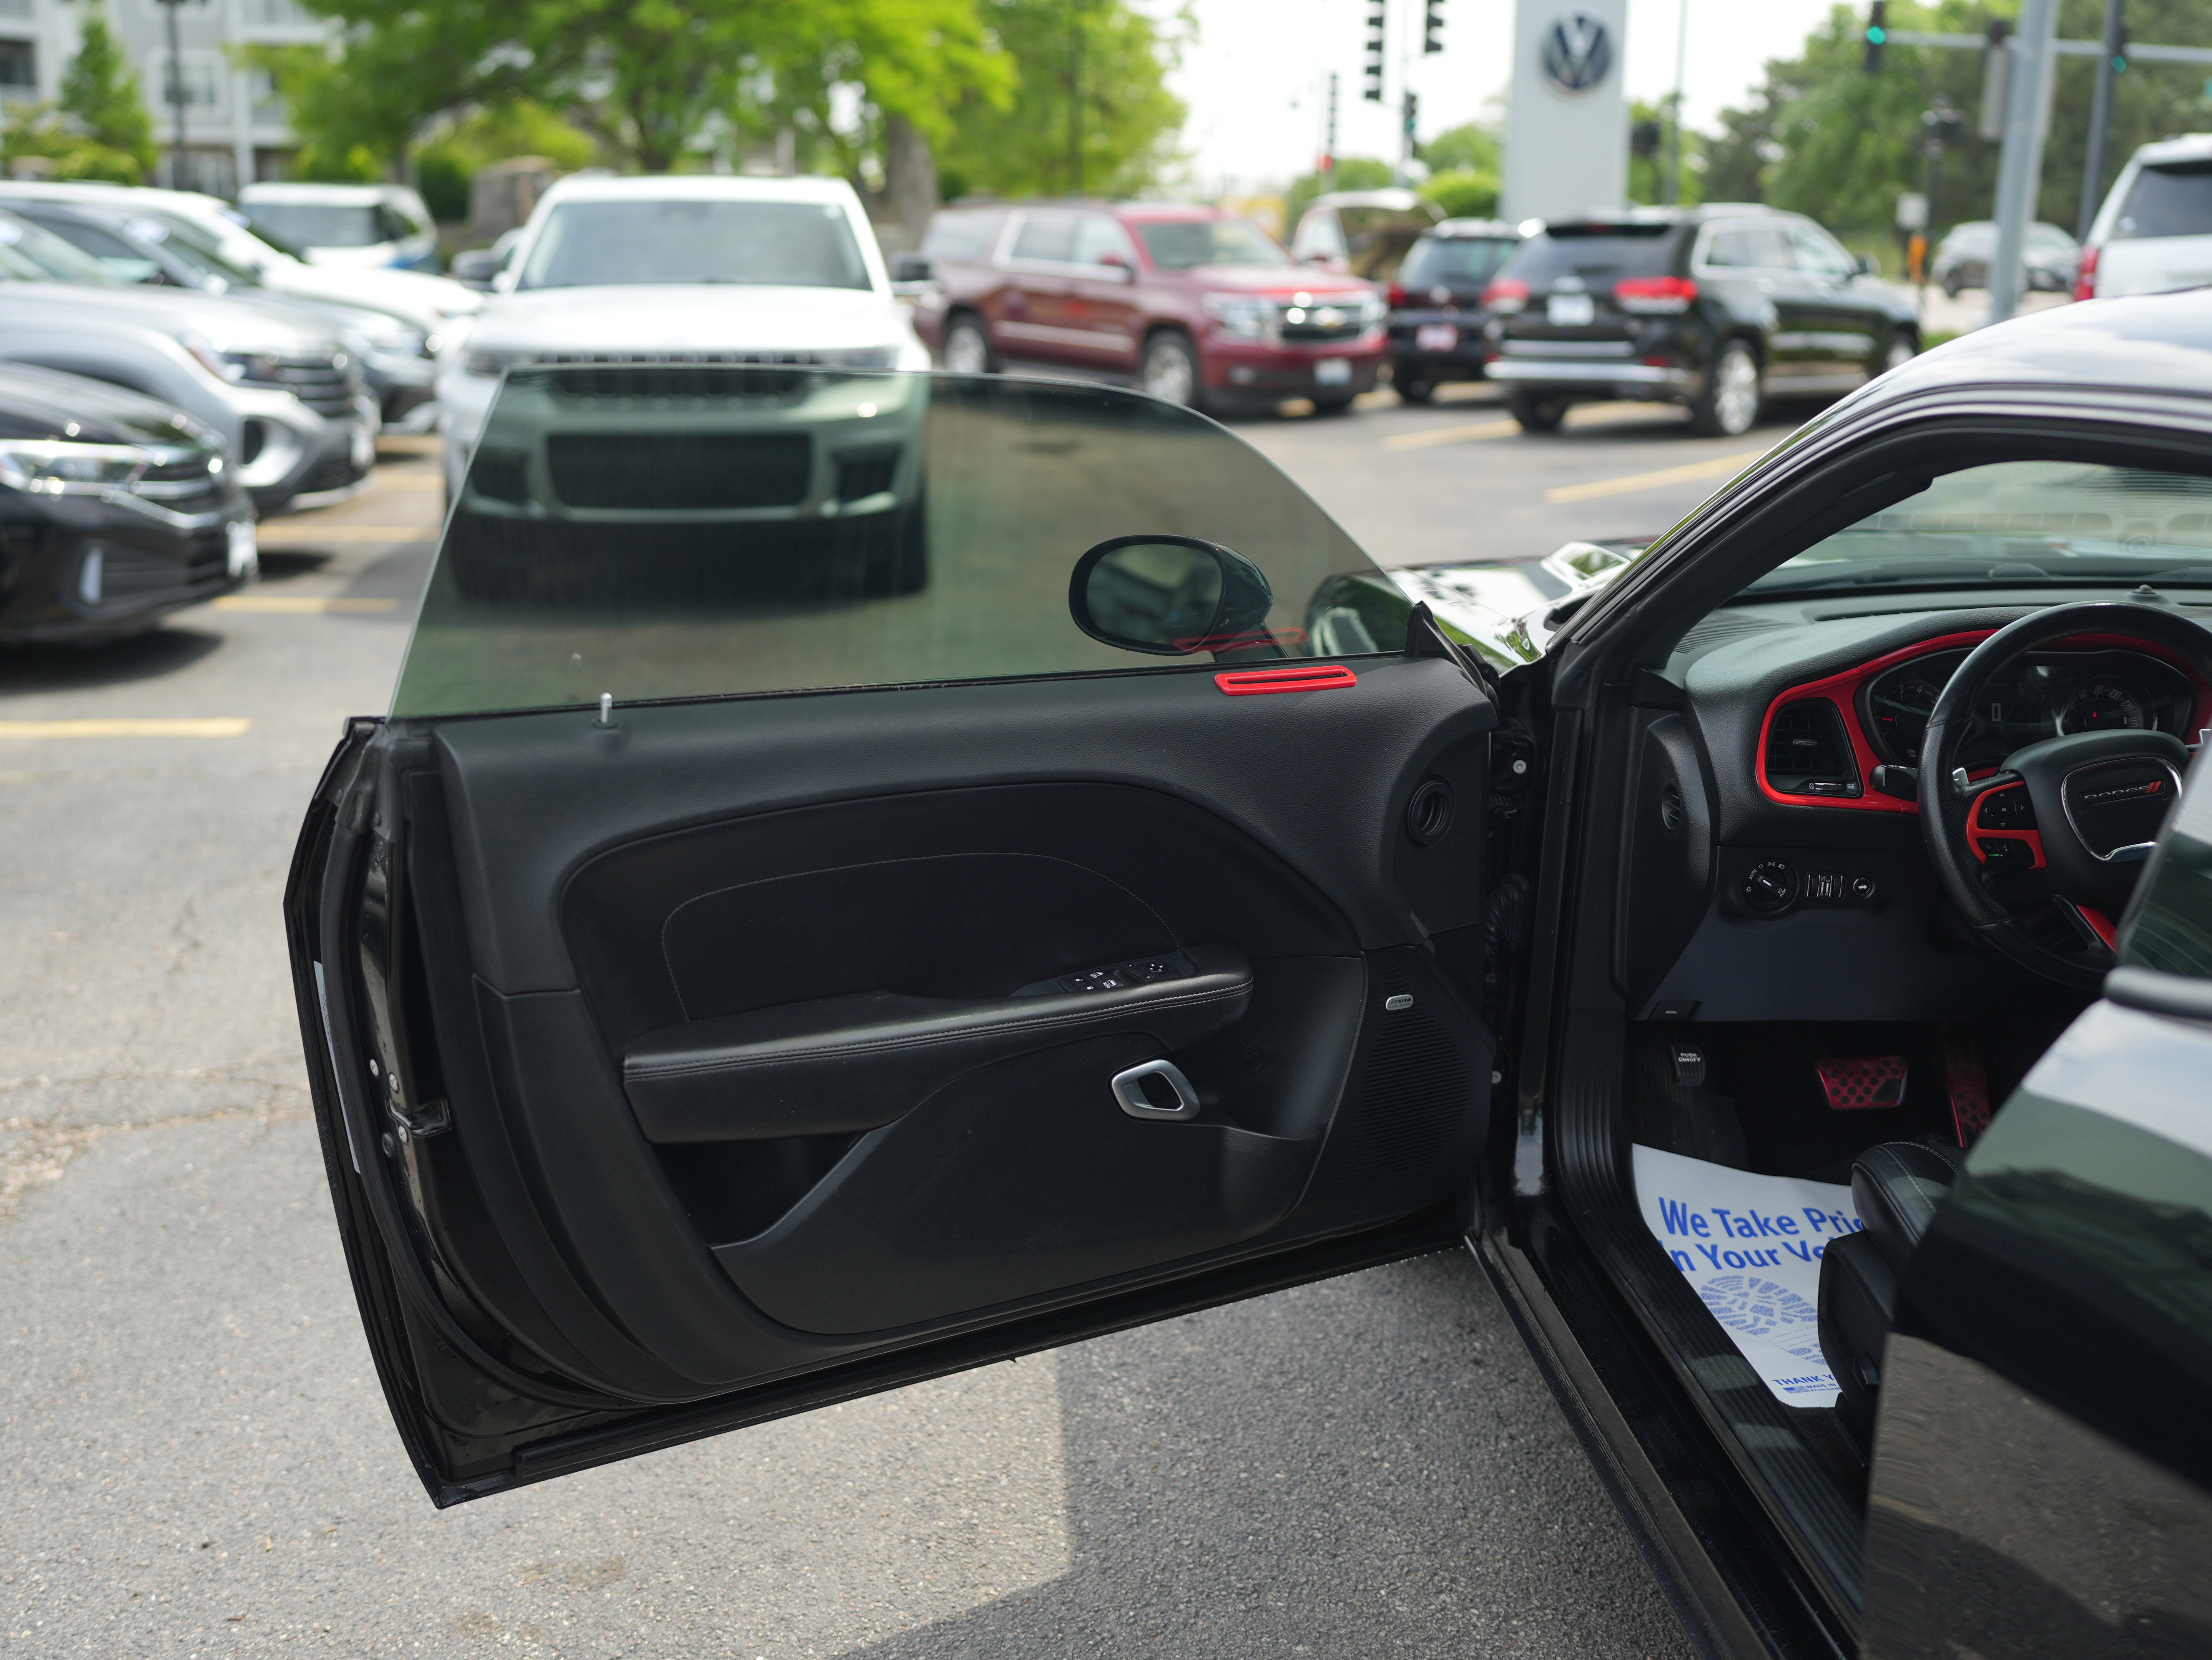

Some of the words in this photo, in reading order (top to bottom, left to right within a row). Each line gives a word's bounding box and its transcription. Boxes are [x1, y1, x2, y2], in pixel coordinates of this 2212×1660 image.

[1899, 684, 1903, 693] 3
[1916, 685, 1923, 694] 4
[2108, 689, 2122, 700] 100
[2120, 700, 2134, 712] 120
[2084, 785, 2149, 800] DODGE
[1748, 869, 1757, 880] AUTO
[1659, 1197, 1710, 1238] We
[1711, 1207, 1800, 1238] Take
[1657, 1240, 1697, 1271] n
[1695, 1243, 1782, 1270] Your
[1772, 1375, 1825, 1385] THANK
